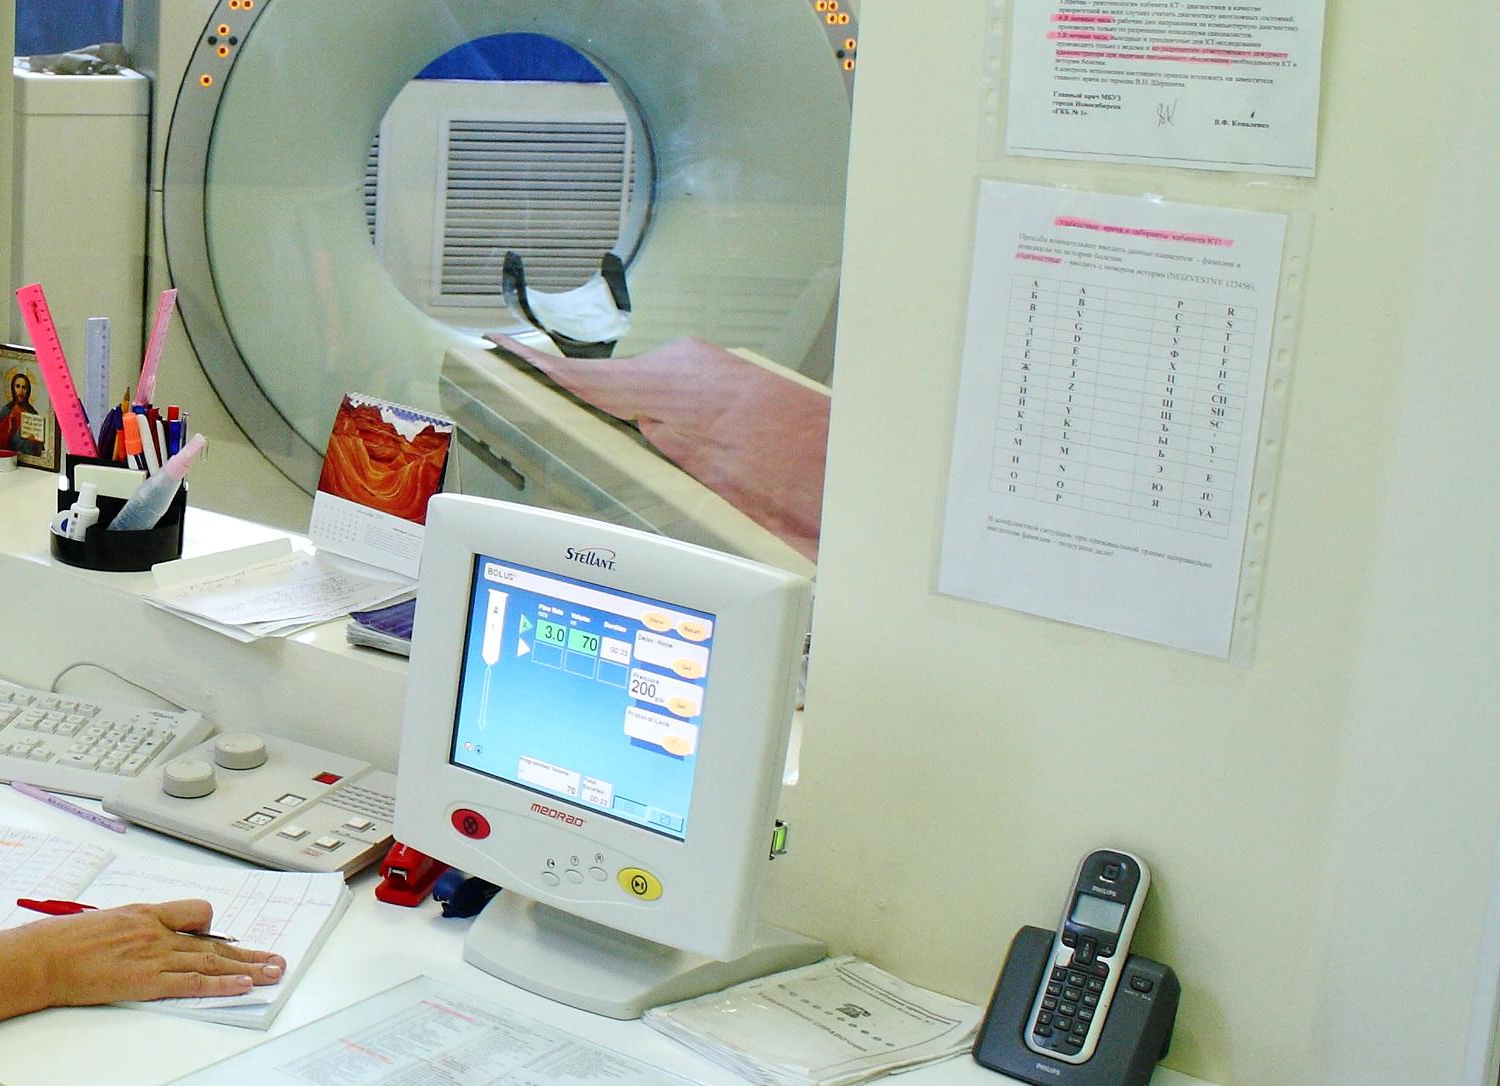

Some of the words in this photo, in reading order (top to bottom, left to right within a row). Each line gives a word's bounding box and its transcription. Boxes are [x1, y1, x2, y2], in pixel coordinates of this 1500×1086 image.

[545, 625, 565, 642] 3.0
[582, 635, 598, 652] 70
[631, 679, 661, 698] 200
